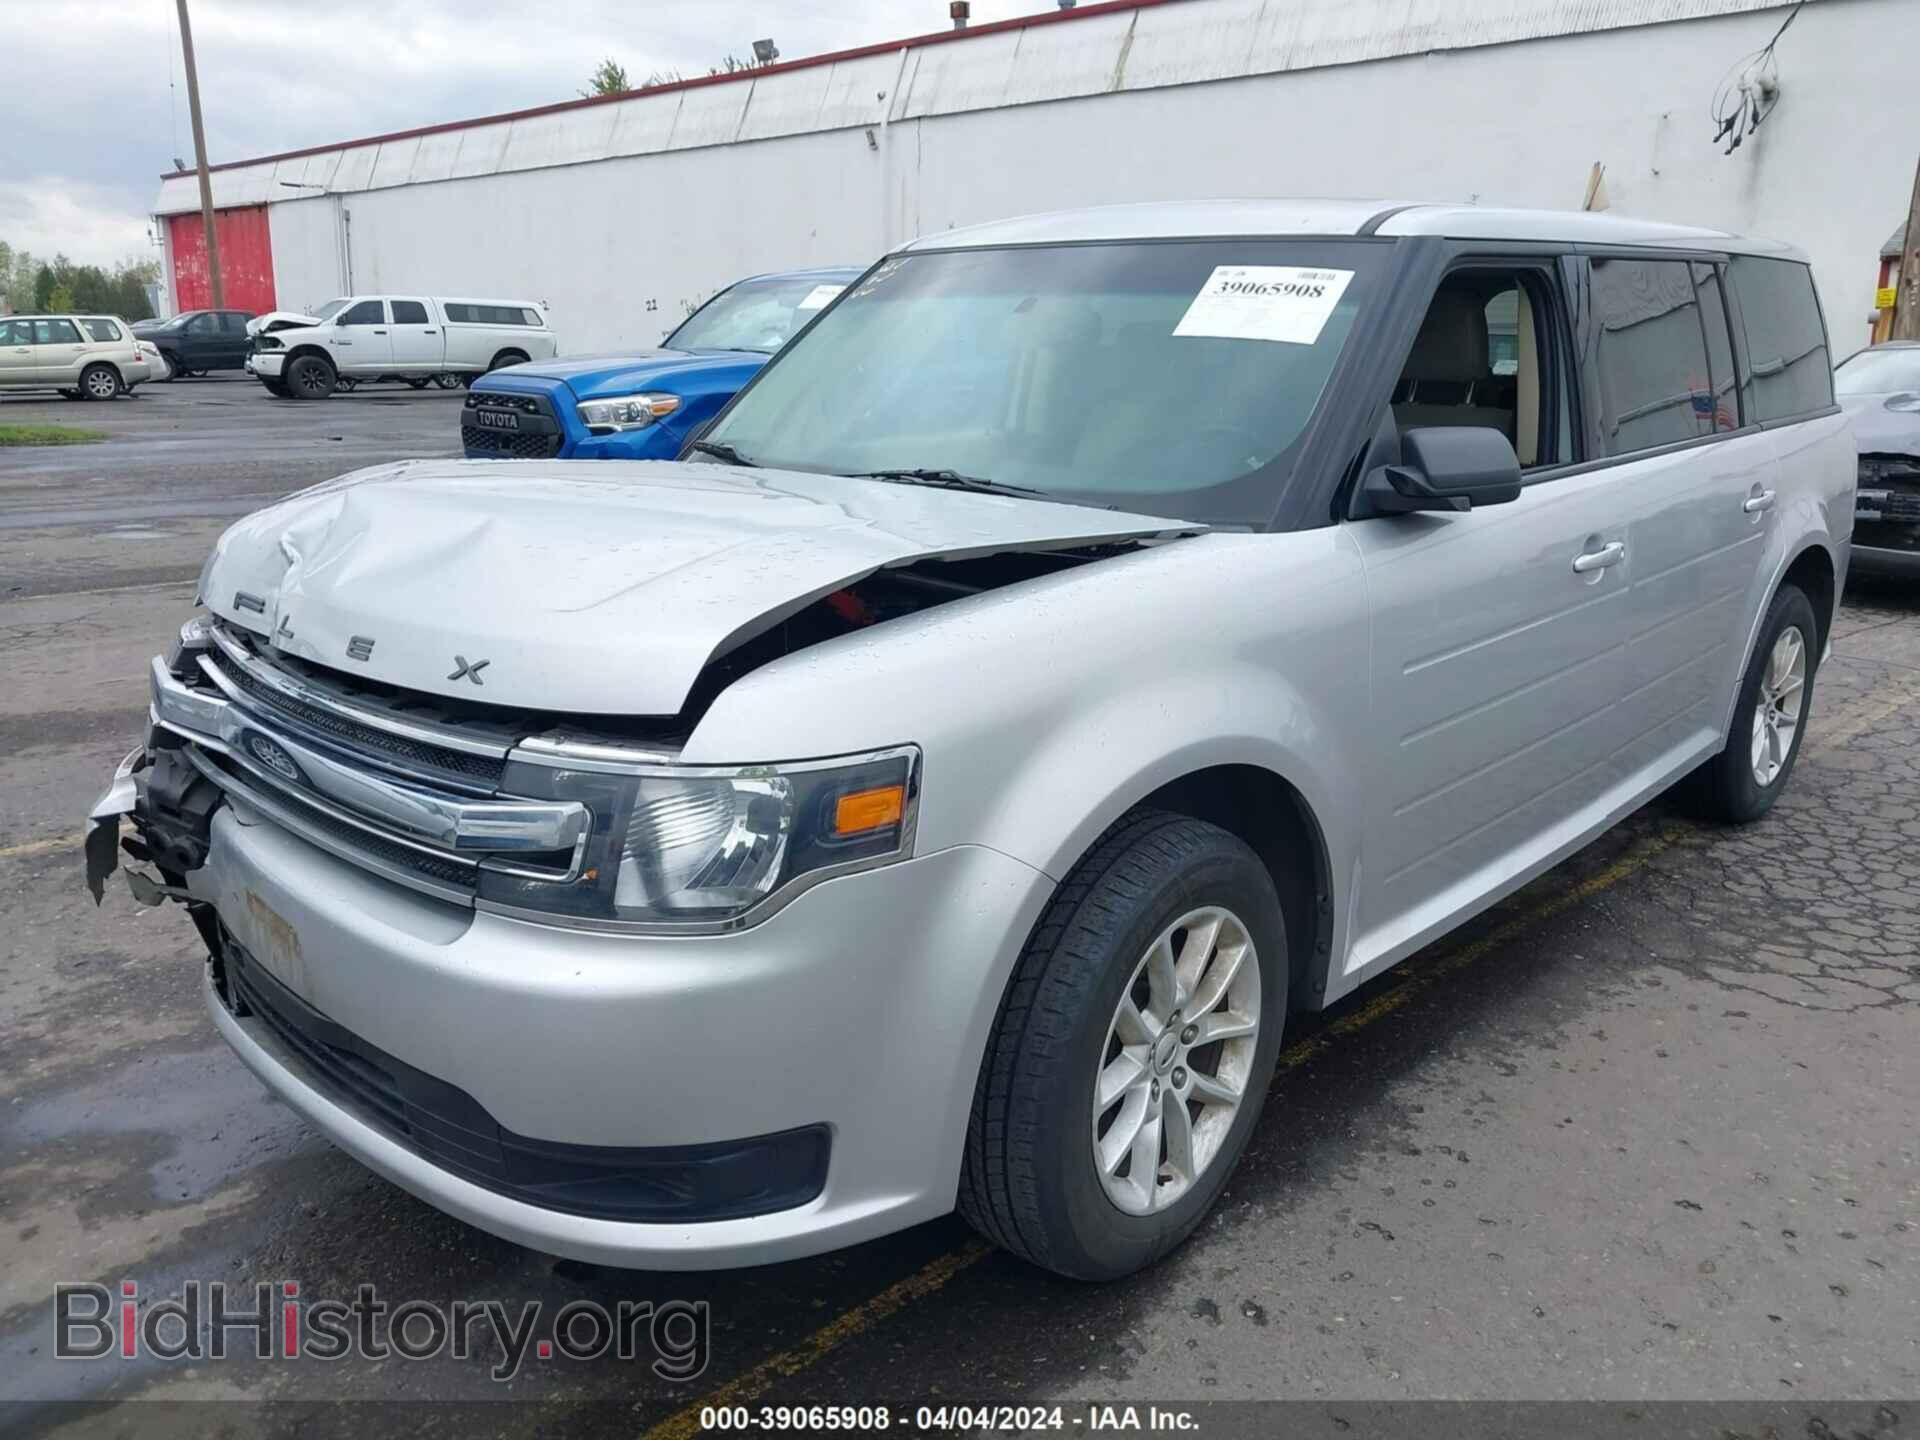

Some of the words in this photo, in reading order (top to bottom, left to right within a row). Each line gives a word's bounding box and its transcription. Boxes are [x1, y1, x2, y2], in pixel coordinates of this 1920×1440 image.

[1213, 281, 1326, 298] 39065908
[478, 410, 518, 428] TOYOTA
[233, 591, 490, 685] FLEX
